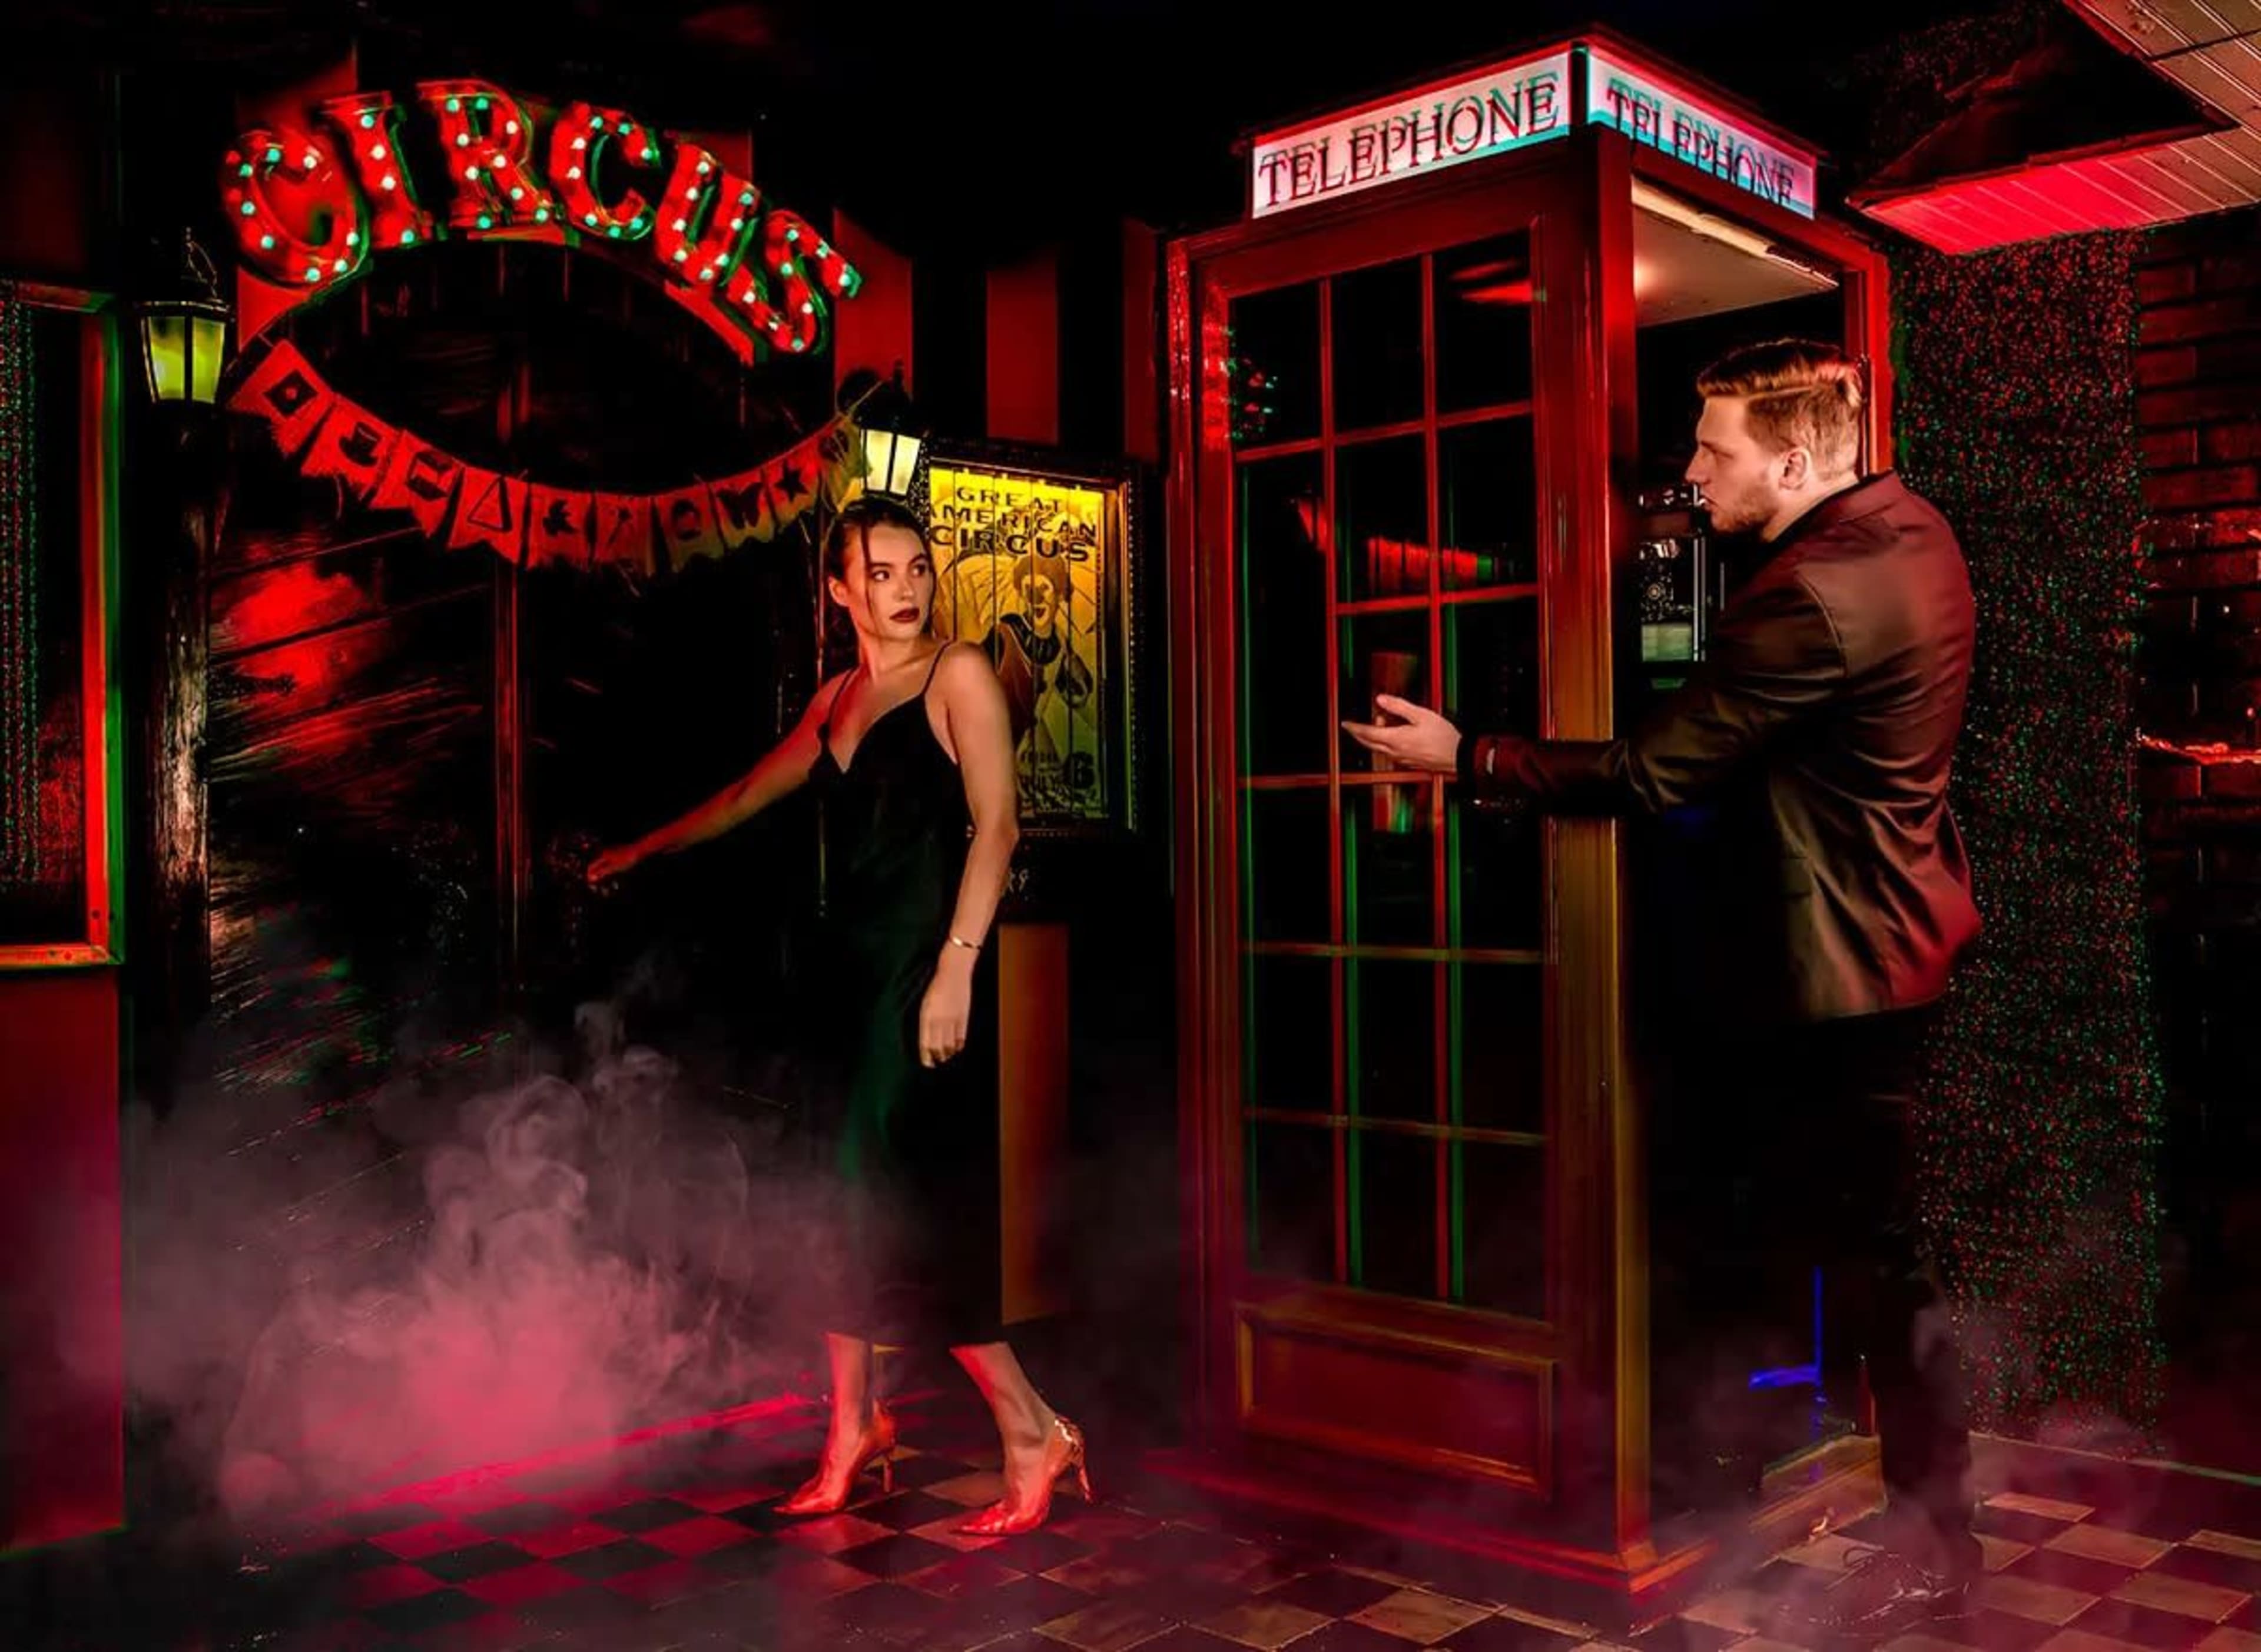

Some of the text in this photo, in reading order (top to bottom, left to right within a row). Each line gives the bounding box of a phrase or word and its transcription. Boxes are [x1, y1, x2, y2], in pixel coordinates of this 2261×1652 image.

[1258, 71, 1560, 206] TELEPHONE
[1607, 77, 1795, 205] TELEPHONE
[224, 79, 862, 353] CIRCUS
[930, 525, 1089, 562] CIRCUS
[957, 487, 1060, 513] GREAT
